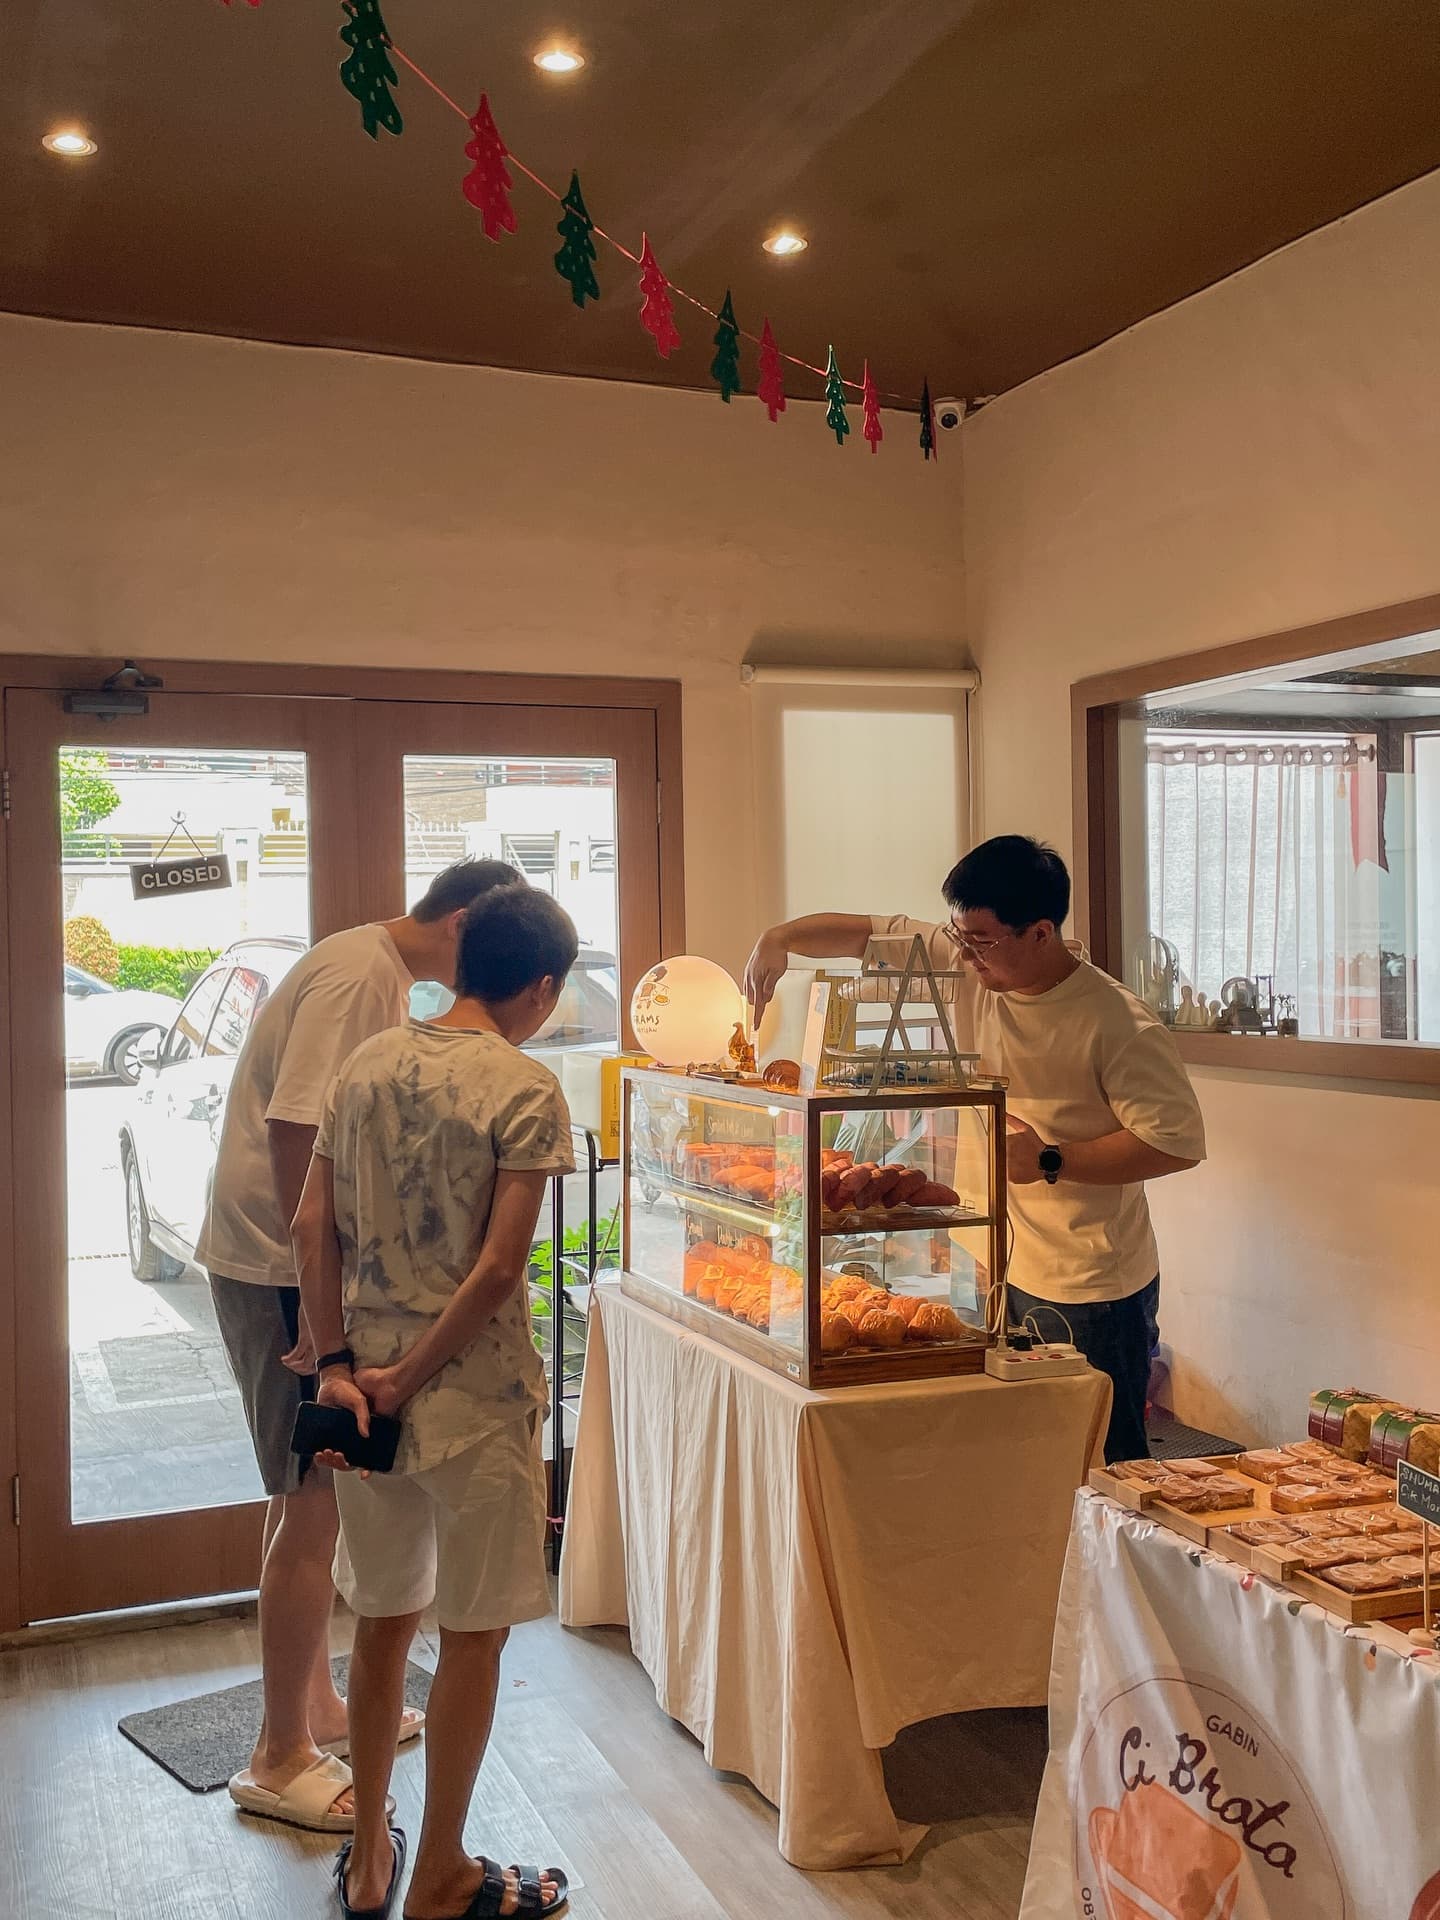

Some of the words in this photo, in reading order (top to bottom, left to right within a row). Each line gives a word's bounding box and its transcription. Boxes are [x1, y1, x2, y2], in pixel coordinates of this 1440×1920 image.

[141, 865, 221, 889] CLOSED
[1206, 1715, 1260, 1757] GABIN
[1119, 1726, 1156, 1792] Ci
[1168, 1732, 1297, 1879] Brata
